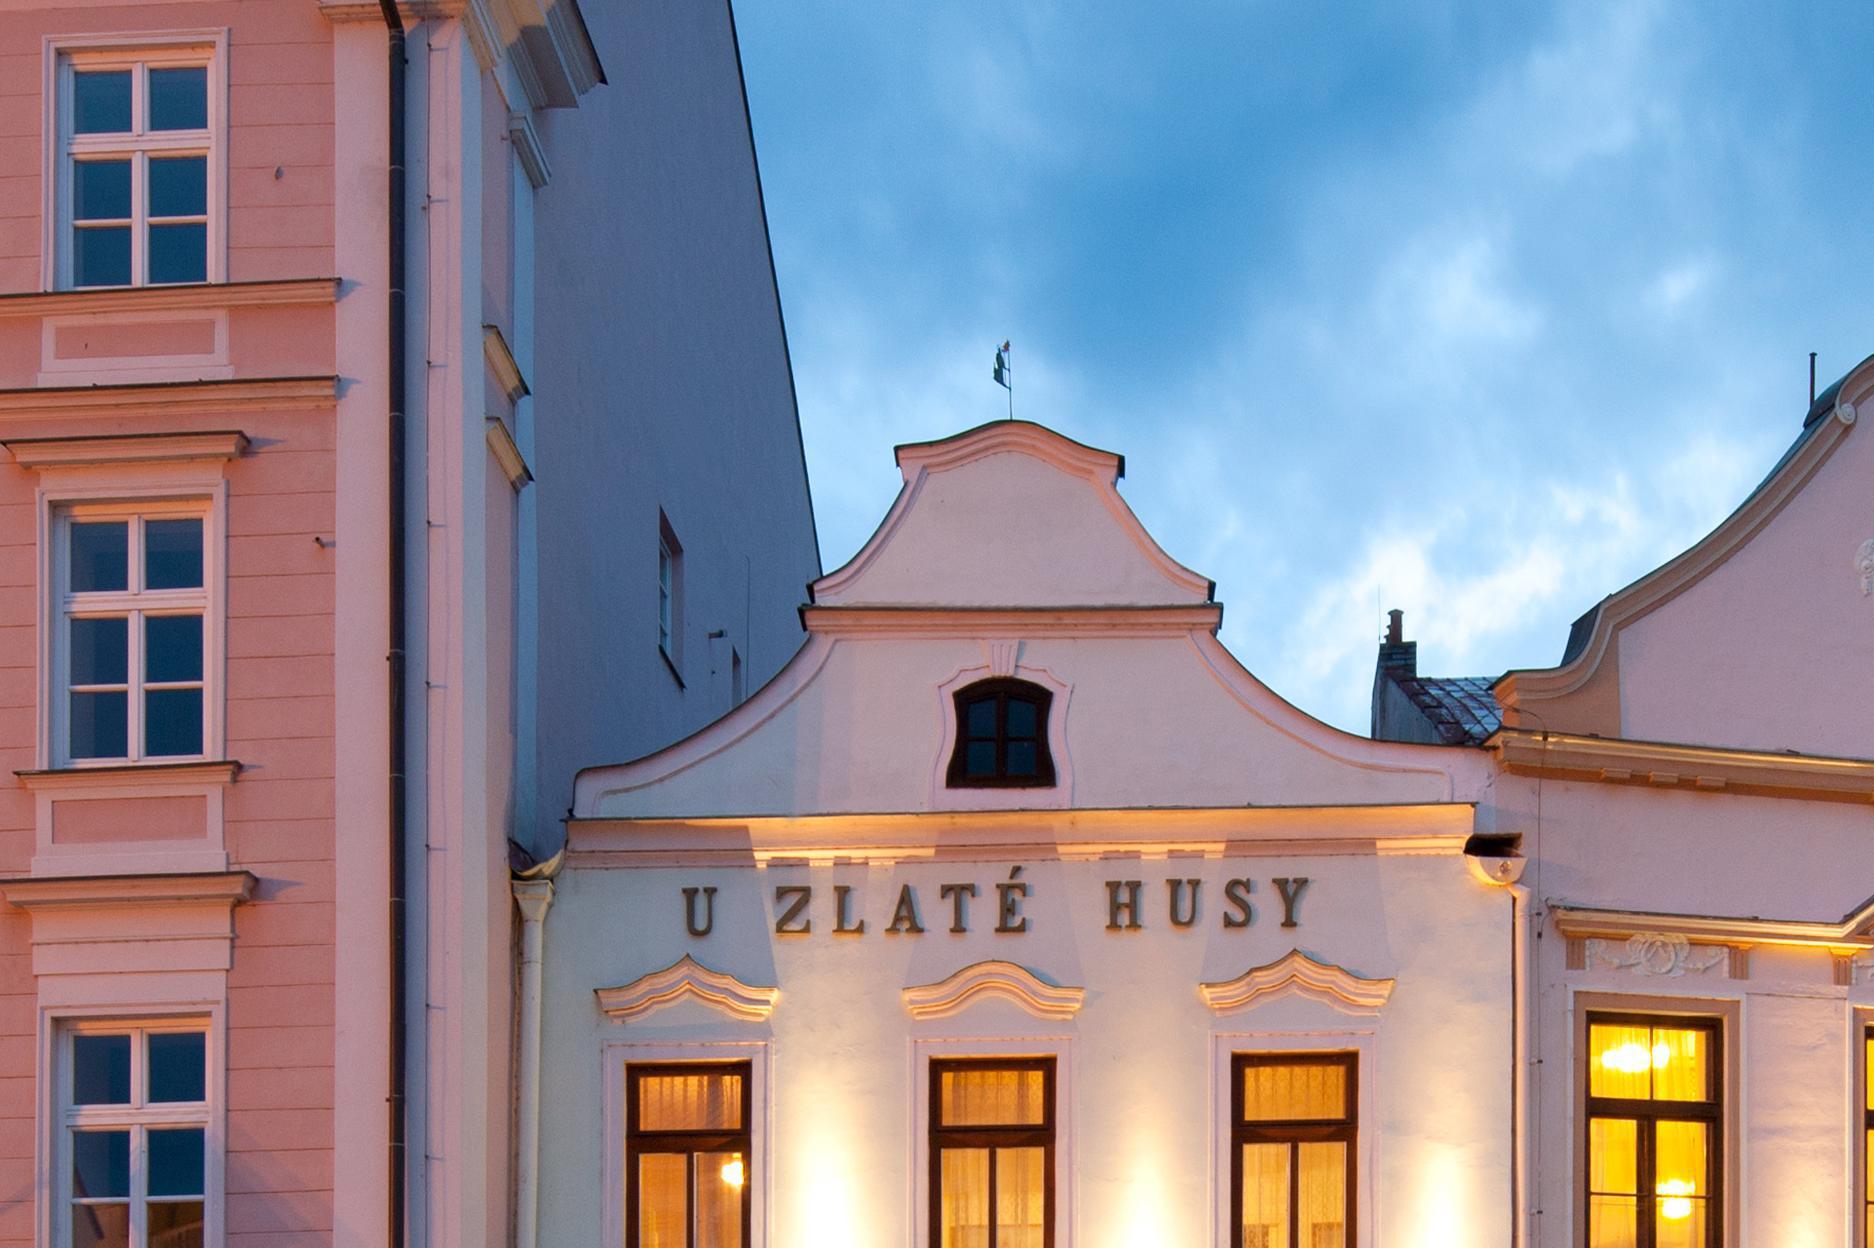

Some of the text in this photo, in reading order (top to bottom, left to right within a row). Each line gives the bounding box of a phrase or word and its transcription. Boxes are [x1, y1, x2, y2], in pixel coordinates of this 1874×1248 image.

[681, 865, 1308, 936] U ZLATÉ HUSY
